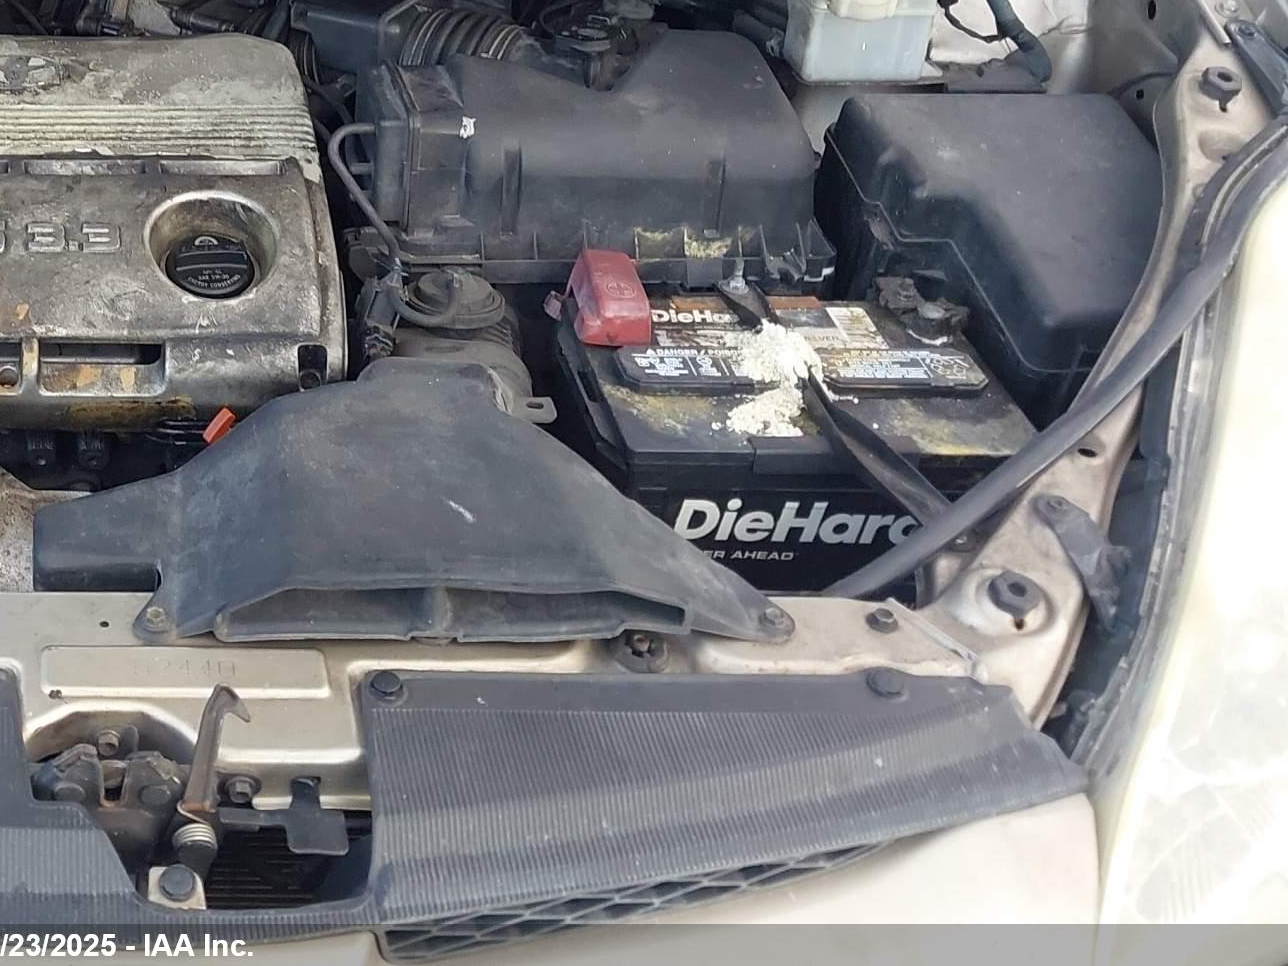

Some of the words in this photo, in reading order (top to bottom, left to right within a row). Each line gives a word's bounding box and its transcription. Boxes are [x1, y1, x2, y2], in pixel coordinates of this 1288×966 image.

[27, 221, 122, 253] 3.3
[651, 308, 740, 324] DieHa
[656, 348, 698, 356] DANGER
[730, 550, 796, 562] AHEAD
